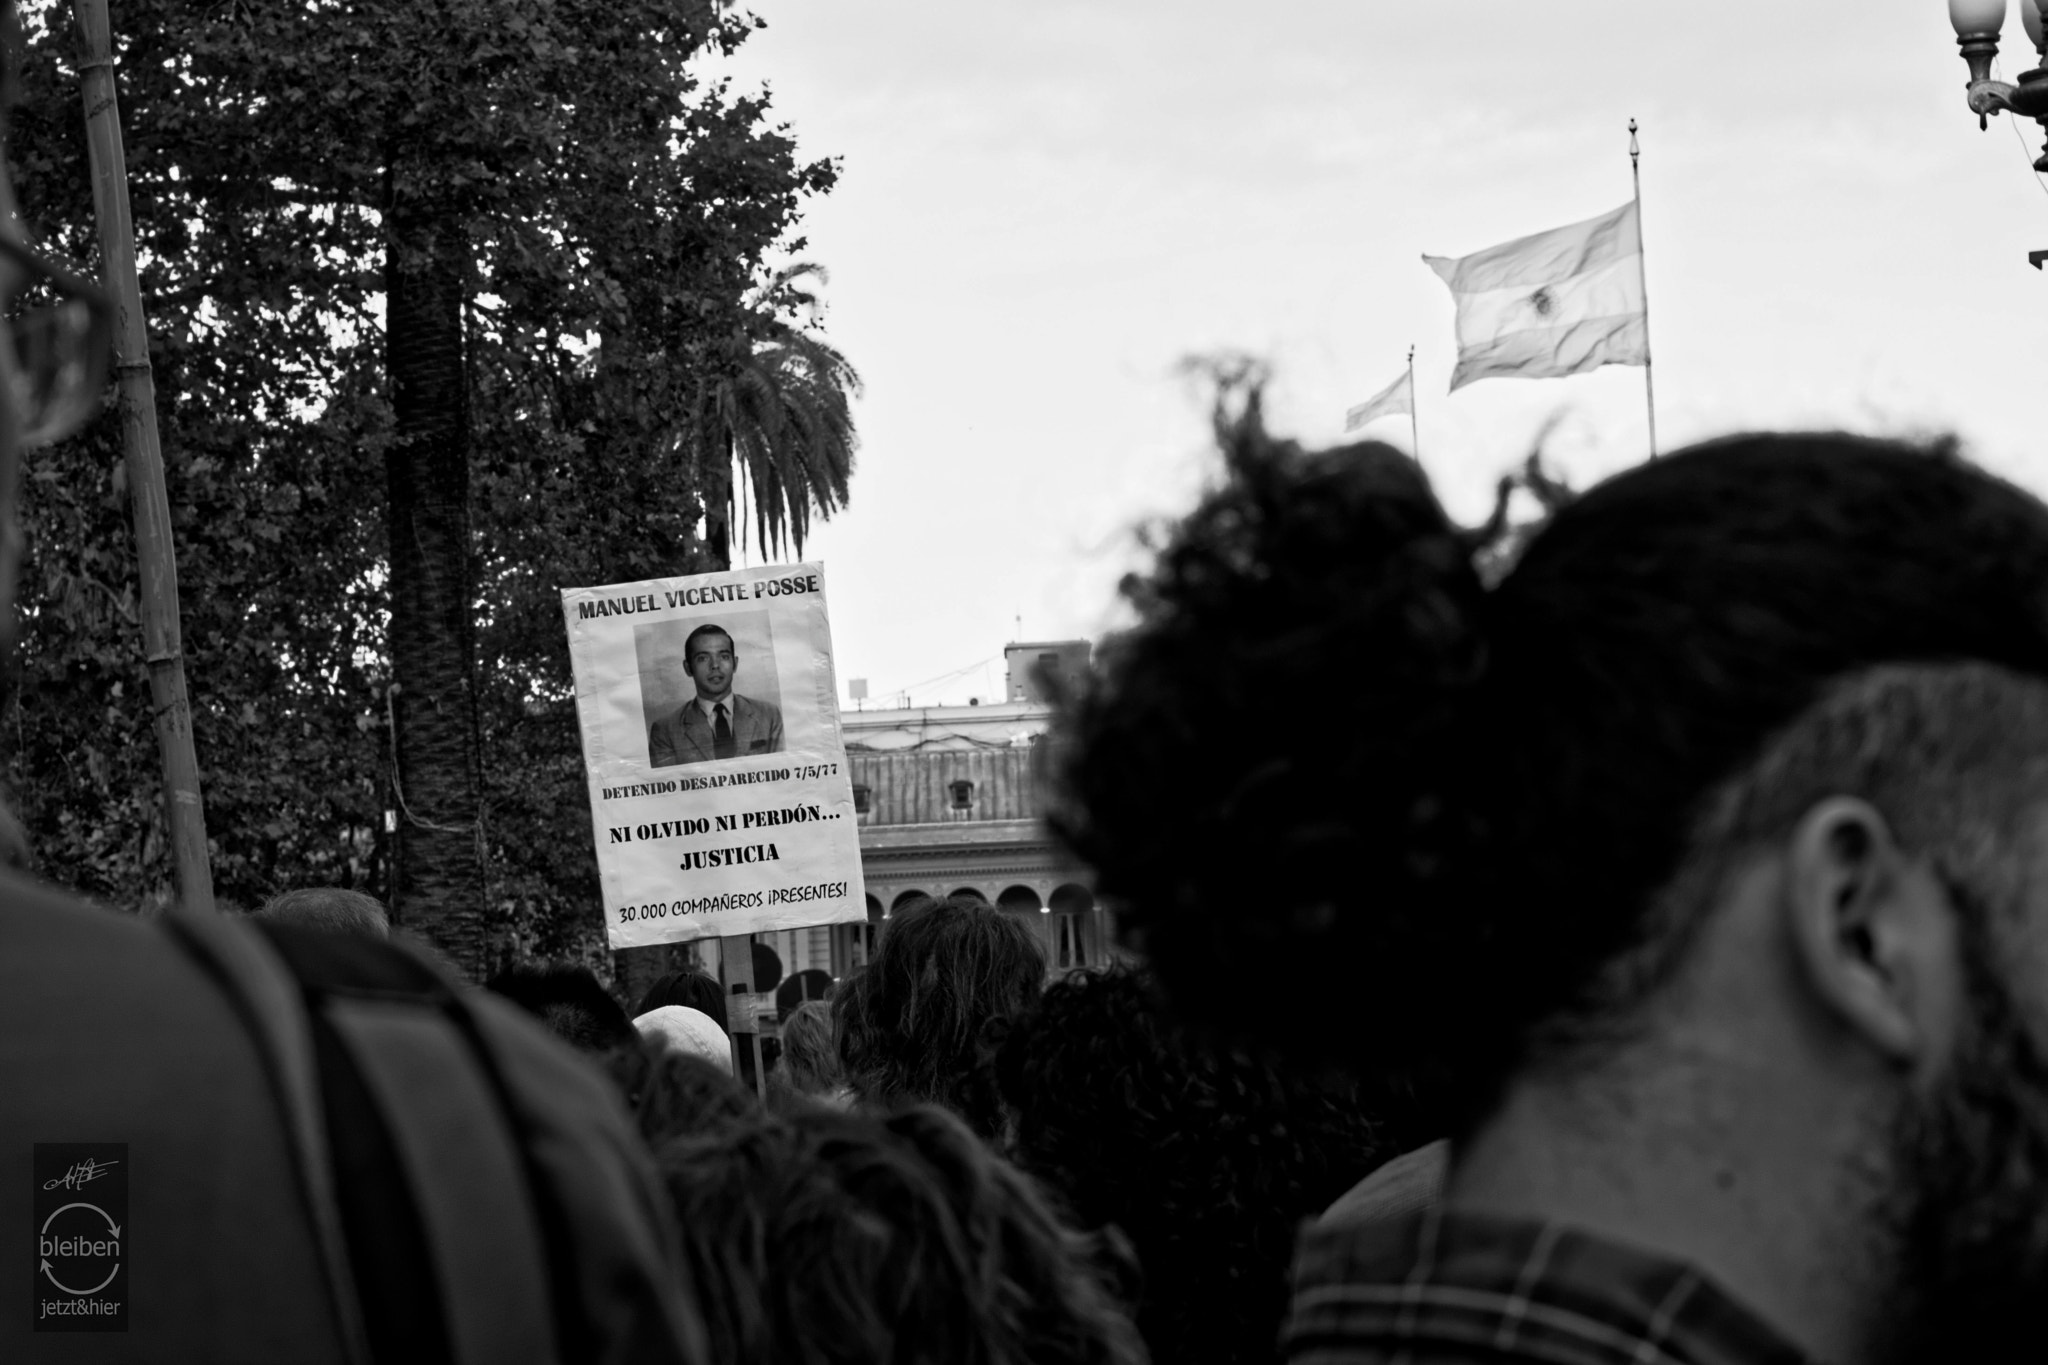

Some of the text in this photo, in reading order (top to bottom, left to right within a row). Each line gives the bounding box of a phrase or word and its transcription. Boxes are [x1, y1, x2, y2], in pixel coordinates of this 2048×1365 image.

[578, 575, 819, 619] MANUEL VICENTE POSSE
[602, 763, 838, 800] DETENIDO DESAPARECIDO 7/5/77
[609, 803, 841, 844] NI OLVIDO NI PERDÓN...
[680, 843, 780, 871] JUSTICIA
[619, 903, 667, 923] 30.000
[672, 891, 763, 916] COMPAÑEROS
